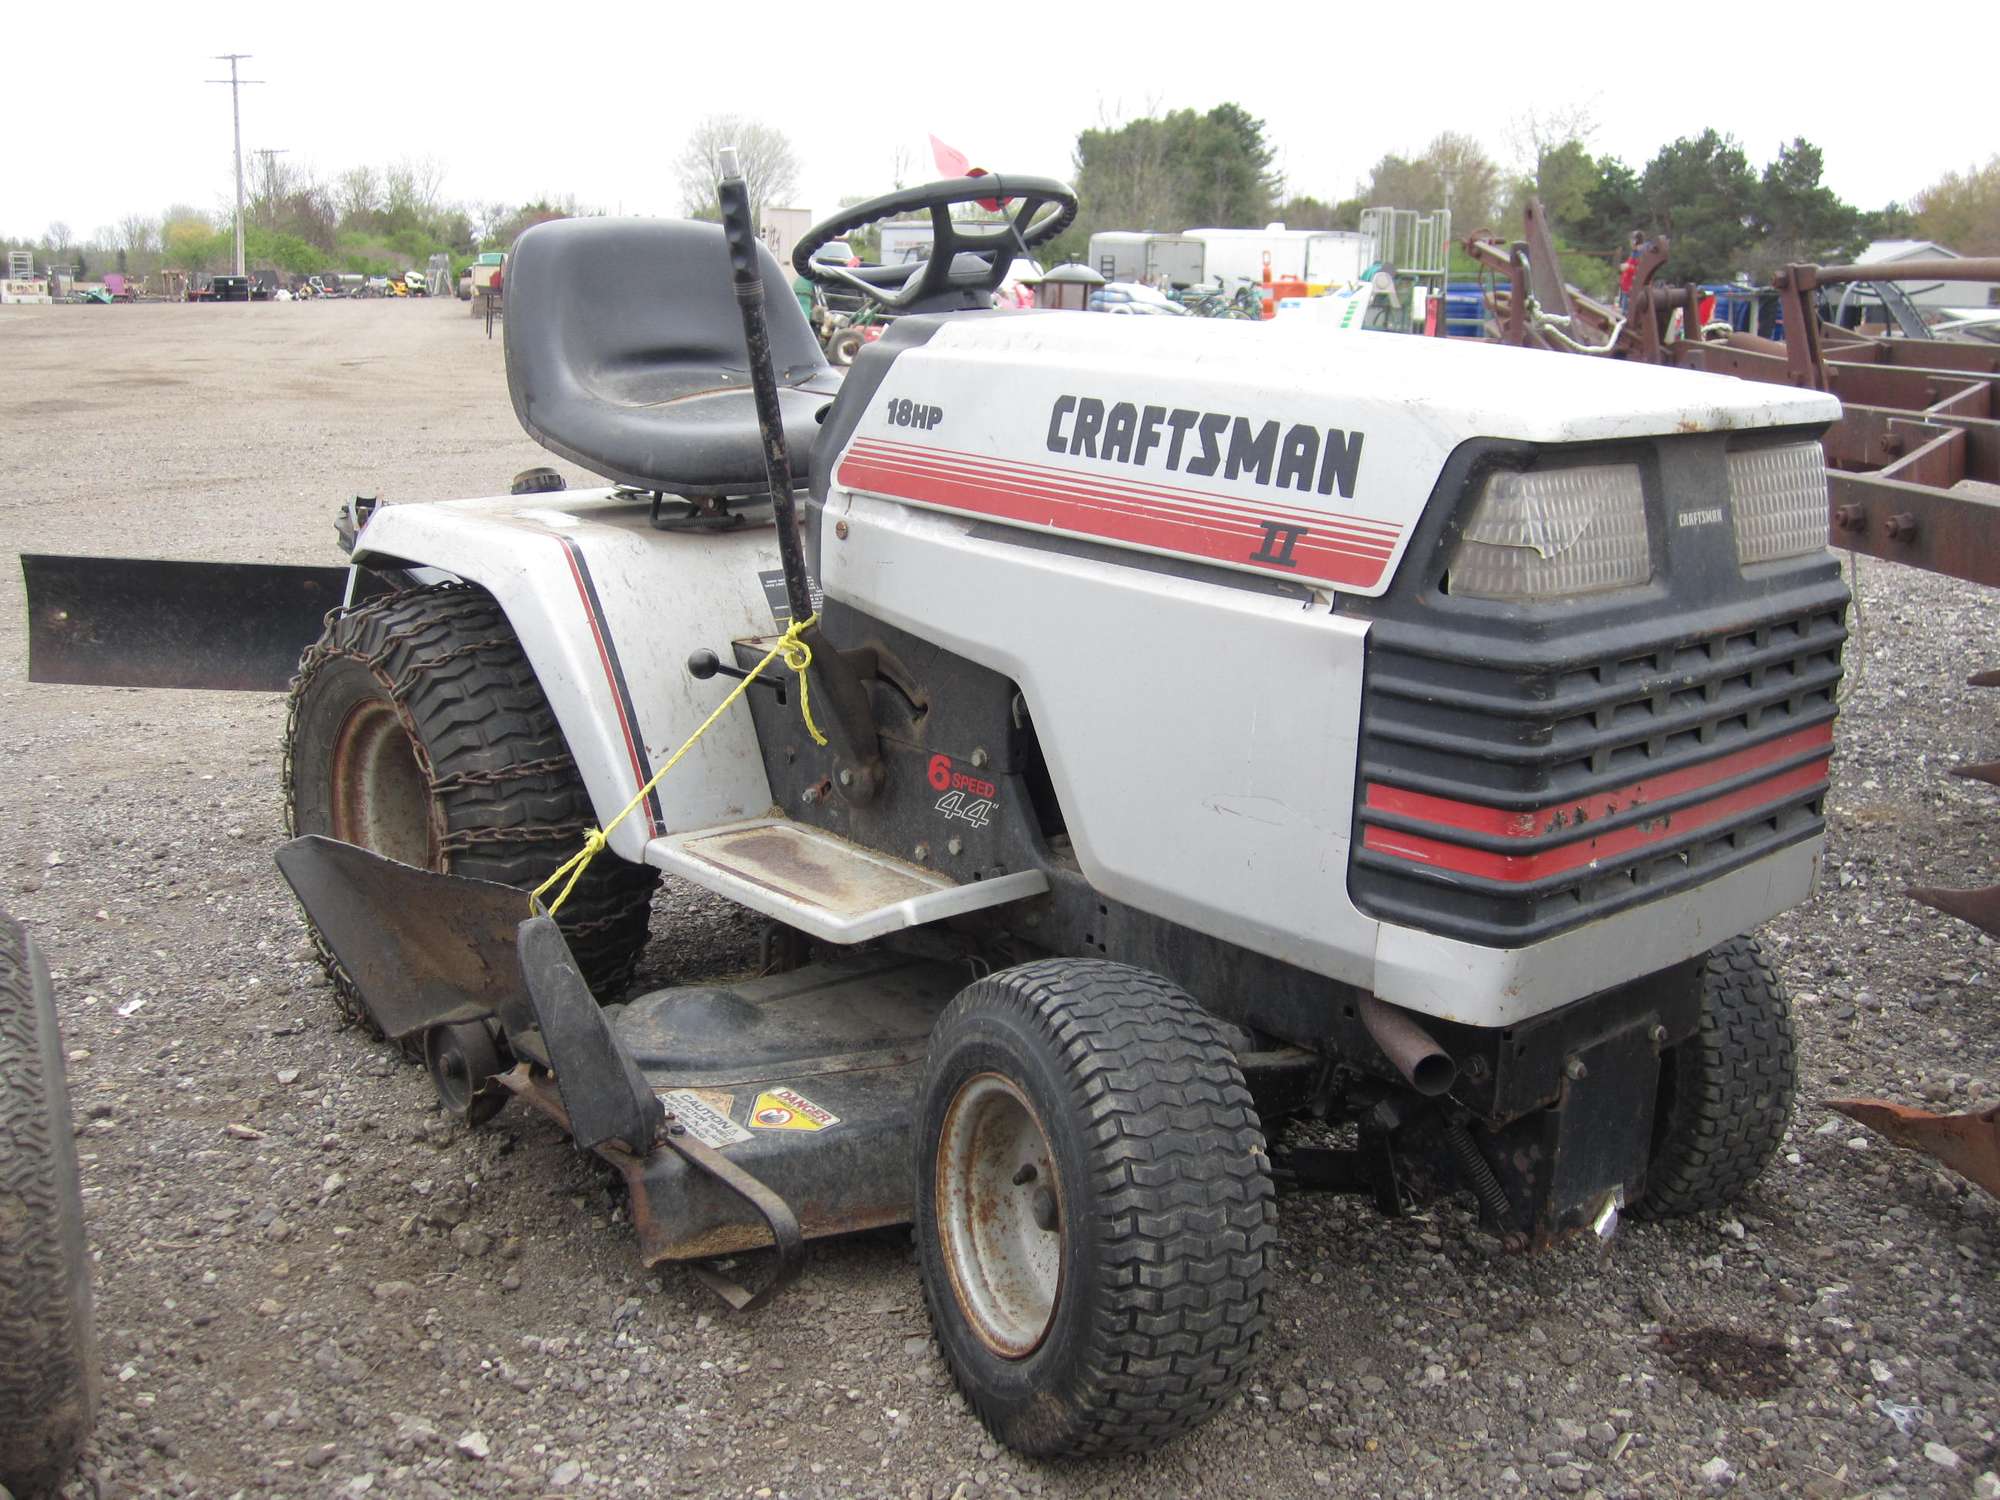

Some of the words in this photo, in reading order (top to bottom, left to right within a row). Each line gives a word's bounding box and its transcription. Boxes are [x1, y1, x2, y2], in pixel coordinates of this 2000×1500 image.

[887, 398, 943, 430] 18HP
[1046, 395, 1365, 499] CRAFTSMAN
[1679, 509, 1723, 526] CRAFTSMAN
[1249, 520, 1309, 567] II
[929, 755, 951, 790] 6
[952, 773, 995, 797] SPEED
[680, 1094, 730, 1130] CAUTION
[777, 1091, 831, 1122] DANGER
